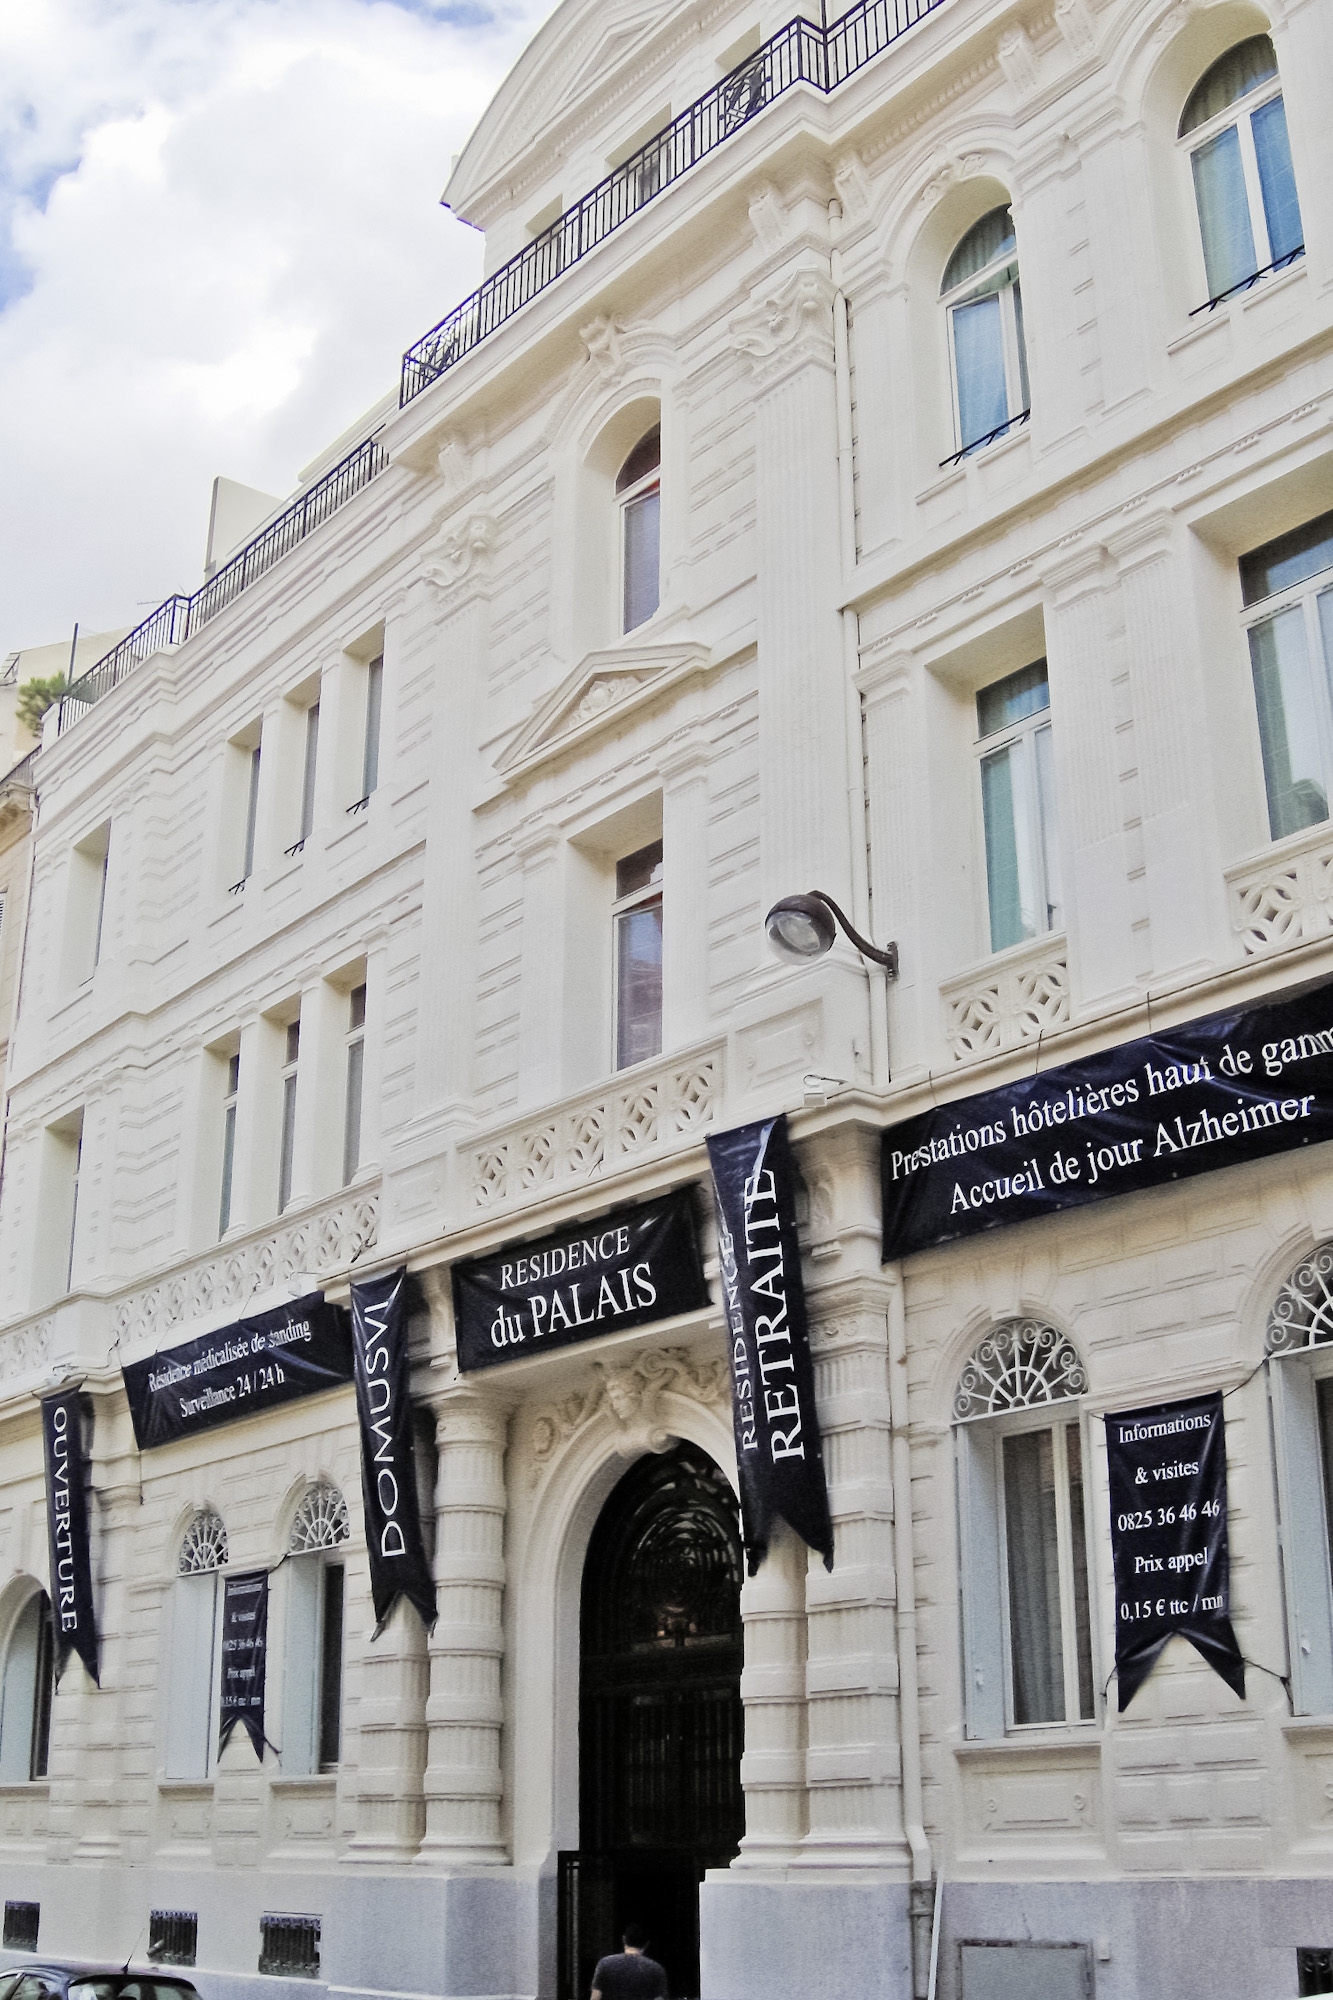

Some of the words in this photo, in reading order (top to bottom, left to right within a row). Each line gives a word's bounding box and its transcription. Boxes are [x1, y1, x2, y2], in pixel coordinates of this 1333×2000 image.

[892, 1118, 1006, 1180] Prestations
[1011, 1078, 1140, 1137] hôtelières
[1144, 1057, 1214, 1096] haut
[1219, 1044, 1254, 1077] de
[950, 1161, 1045, 1214] Accueil
[1049, 1151, 1081, 1185] de
[1087, 1138, 1143, 1184] jour
[1152, 1094, 1316, 1158] Alzheimer
[500, 1226, 631, 1290] RESIDENCE
[490, 1305, 526, 1348] du
[527, 1262, 657, 1338] PALAIS
[744, 1169, 805, 1463] RETRAITE
[148, 1363, 193, 1392] Résidence
[193, 1337, 250, 1376] médicalisée
[251, 1333, 266, 1354] de
[267, 1319, 312, 1349] standing
[179, 1385, 236, 1418] Surveillance
[236, 1374, 251, 1397] 24
[259, 1366, 275, 1390] 24
[275, 1363, 285, 1385] h
[364, 1301, 406, 1557] DOMUSVI
[1119, 1413, 1211, 1443] Informations
[1134, 1466, 1149, 1485] &
[1153, 1460, 1199, 1481] visites
[53, 1406, 78, 1632] OUVERTURE
[1118, 1510, 1152, 1531] 0825
[1157, 1506, 1175, 1526] 36
[1179, 1502, 1197, 1521] 46
[1201, 1498, 1220, 1518] 46
[1134, 1554, 1164, 1574] Prix
[1168, 1547, 1209, 1573] appel
[1120, 1600, 1152, 1623] 0,15
[1156, 1598, 1166, 1616] €
[1170, 1600, 1189, 1615] ttc
